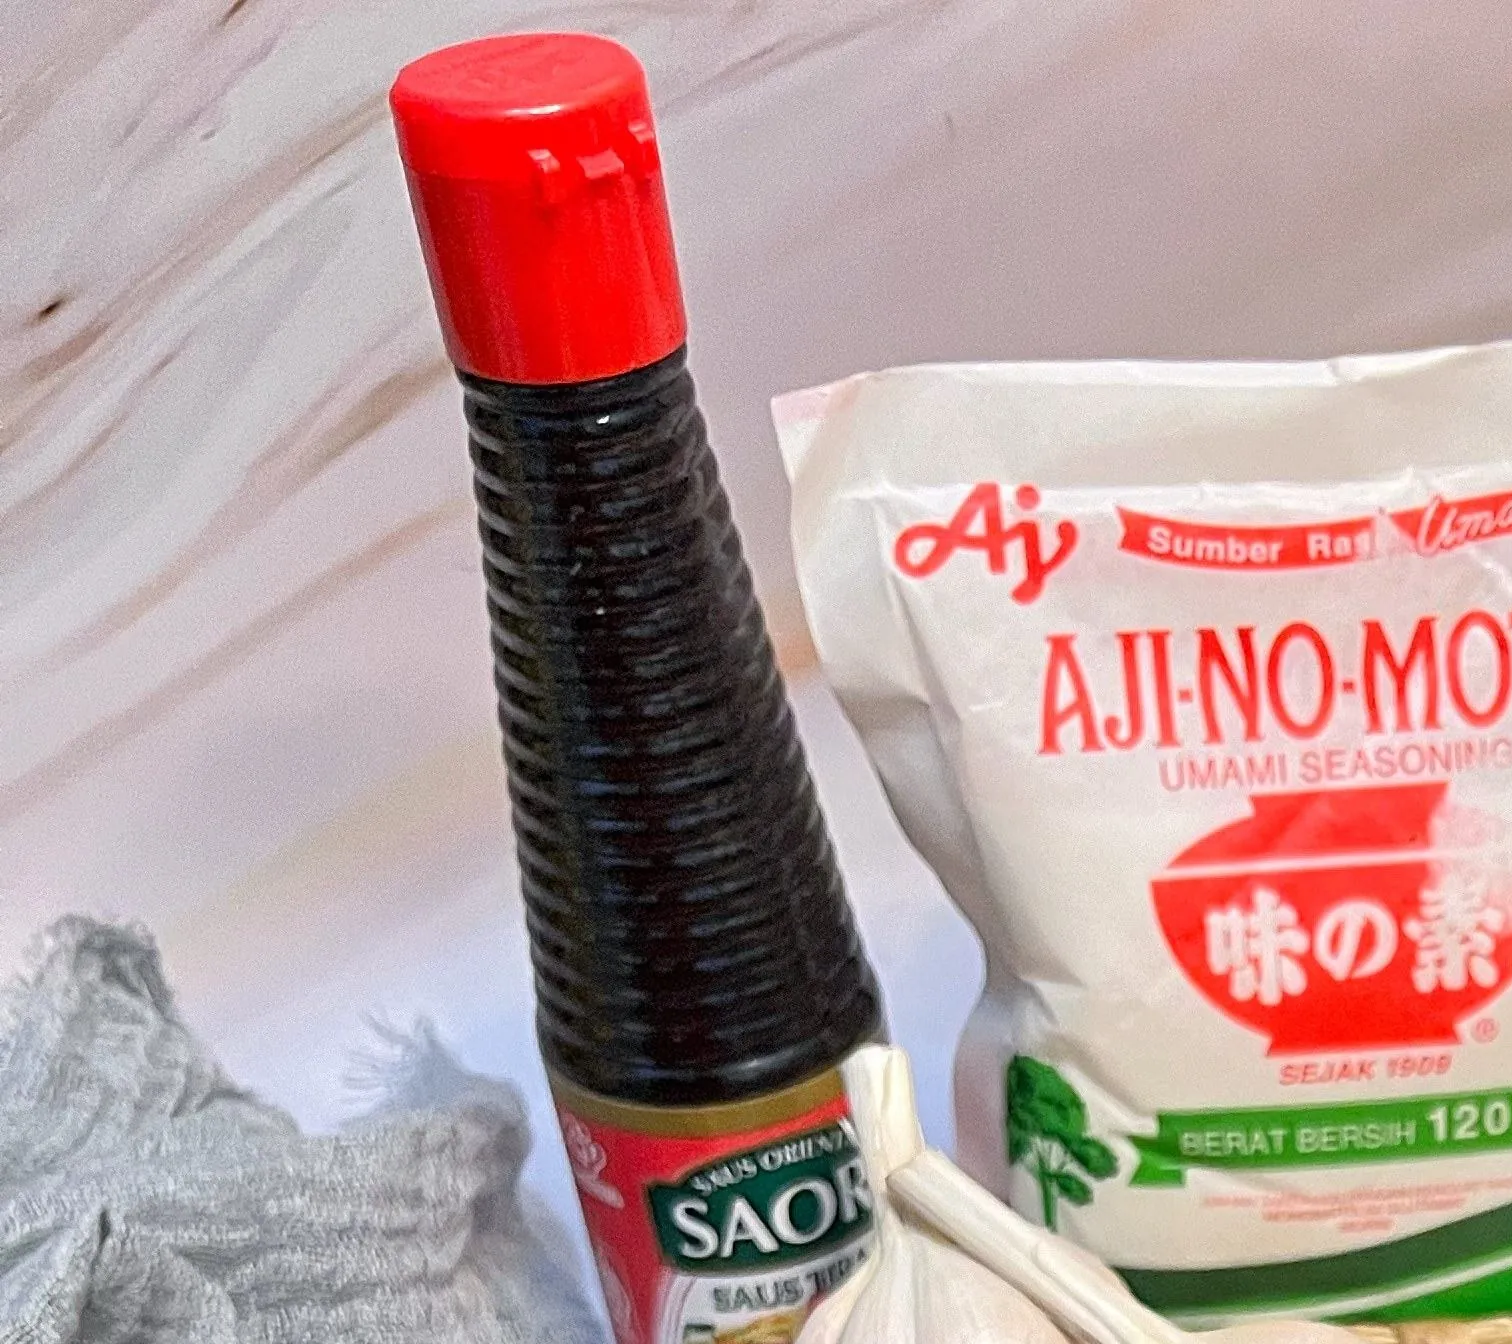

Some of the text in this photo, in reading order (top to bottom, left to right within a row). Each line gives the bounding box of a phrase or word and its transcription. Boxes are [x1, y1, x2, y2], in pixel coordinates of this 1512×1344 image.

[894, 482, 1078, 606] Aj
[1146, 524, 1282, 564] Sumber
[1307, 531, 1376, 562] Ras
[1158, 752, 1288, 793] UMAMI
[1203, 886, 1505, 1007] 味の素
[1279, 1058, 1376, 1086] SEJAK
[1178, 1127, 1288, 1158] BERAT
[1295, 1119, 1418, 1155] BERSIH
[1427, 1101, 1511, 1142] 120
[671, 1158, 873, 1258] SAOR
[714, 1276, 804, 1313] SAUS
